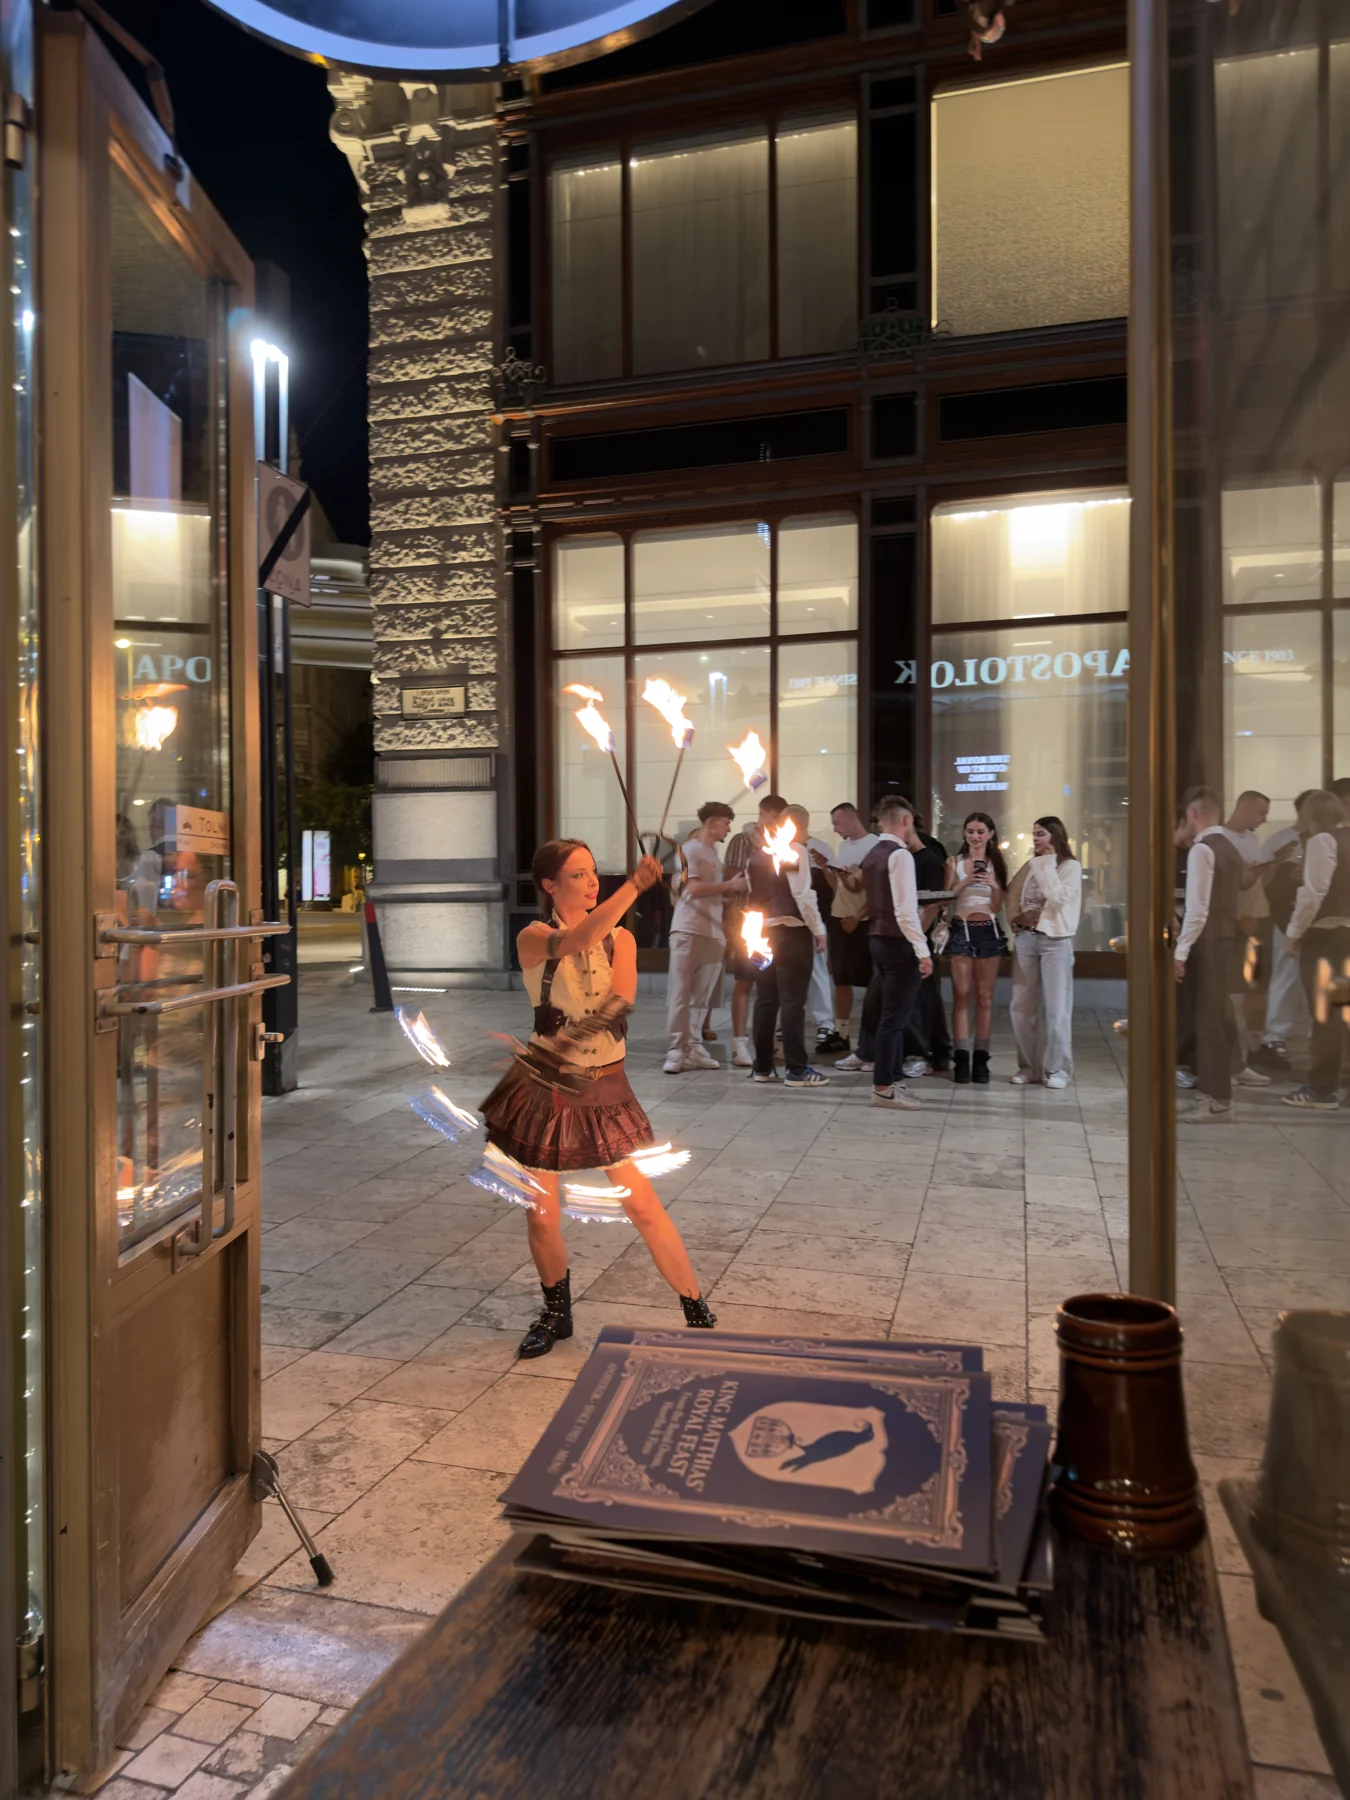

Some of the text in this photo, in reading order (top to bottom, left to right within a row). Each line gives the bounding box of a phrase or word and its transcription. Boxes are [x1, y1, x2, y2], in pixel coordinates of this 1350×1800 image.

[713, 1380, 740, 1413] KING
[667, 1388, 716, 1477] ROYAL FEAST
